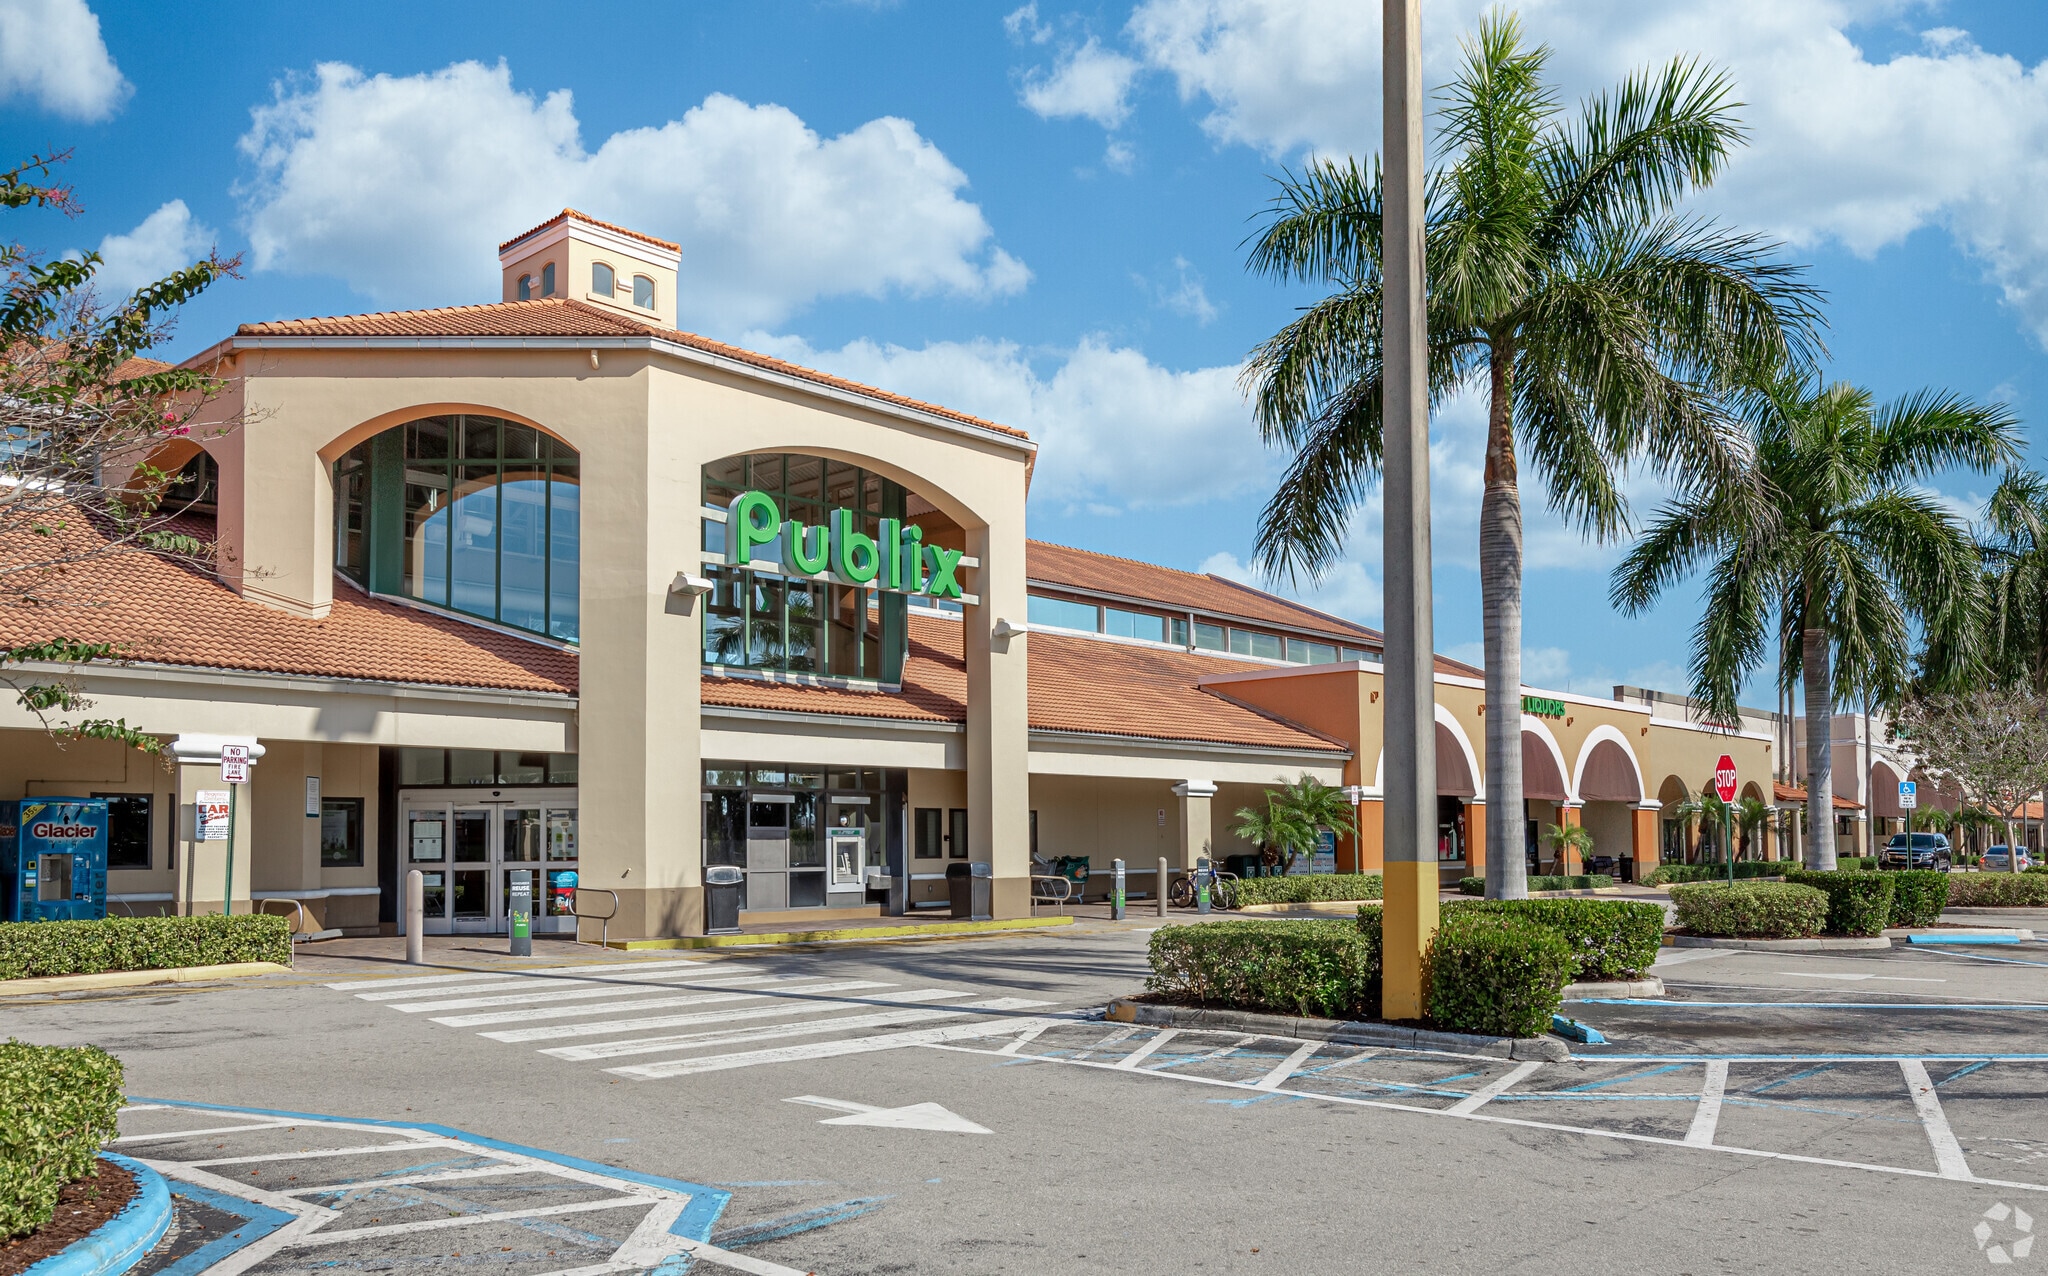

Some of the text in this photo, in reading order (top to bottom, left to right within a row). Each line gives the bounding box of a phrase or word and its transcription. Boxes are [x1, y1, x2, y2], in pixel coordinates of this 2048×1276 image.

[728, 490, 964, 599] Publix
[1525, 696, 1566, 717] LIQUORS
[223, 756, 247, 764] PARKING
[1717, 769, 1736, 788] STOP
[198, 805, 228, 813] CAR
[33, 824, 97, 838] Glacier
